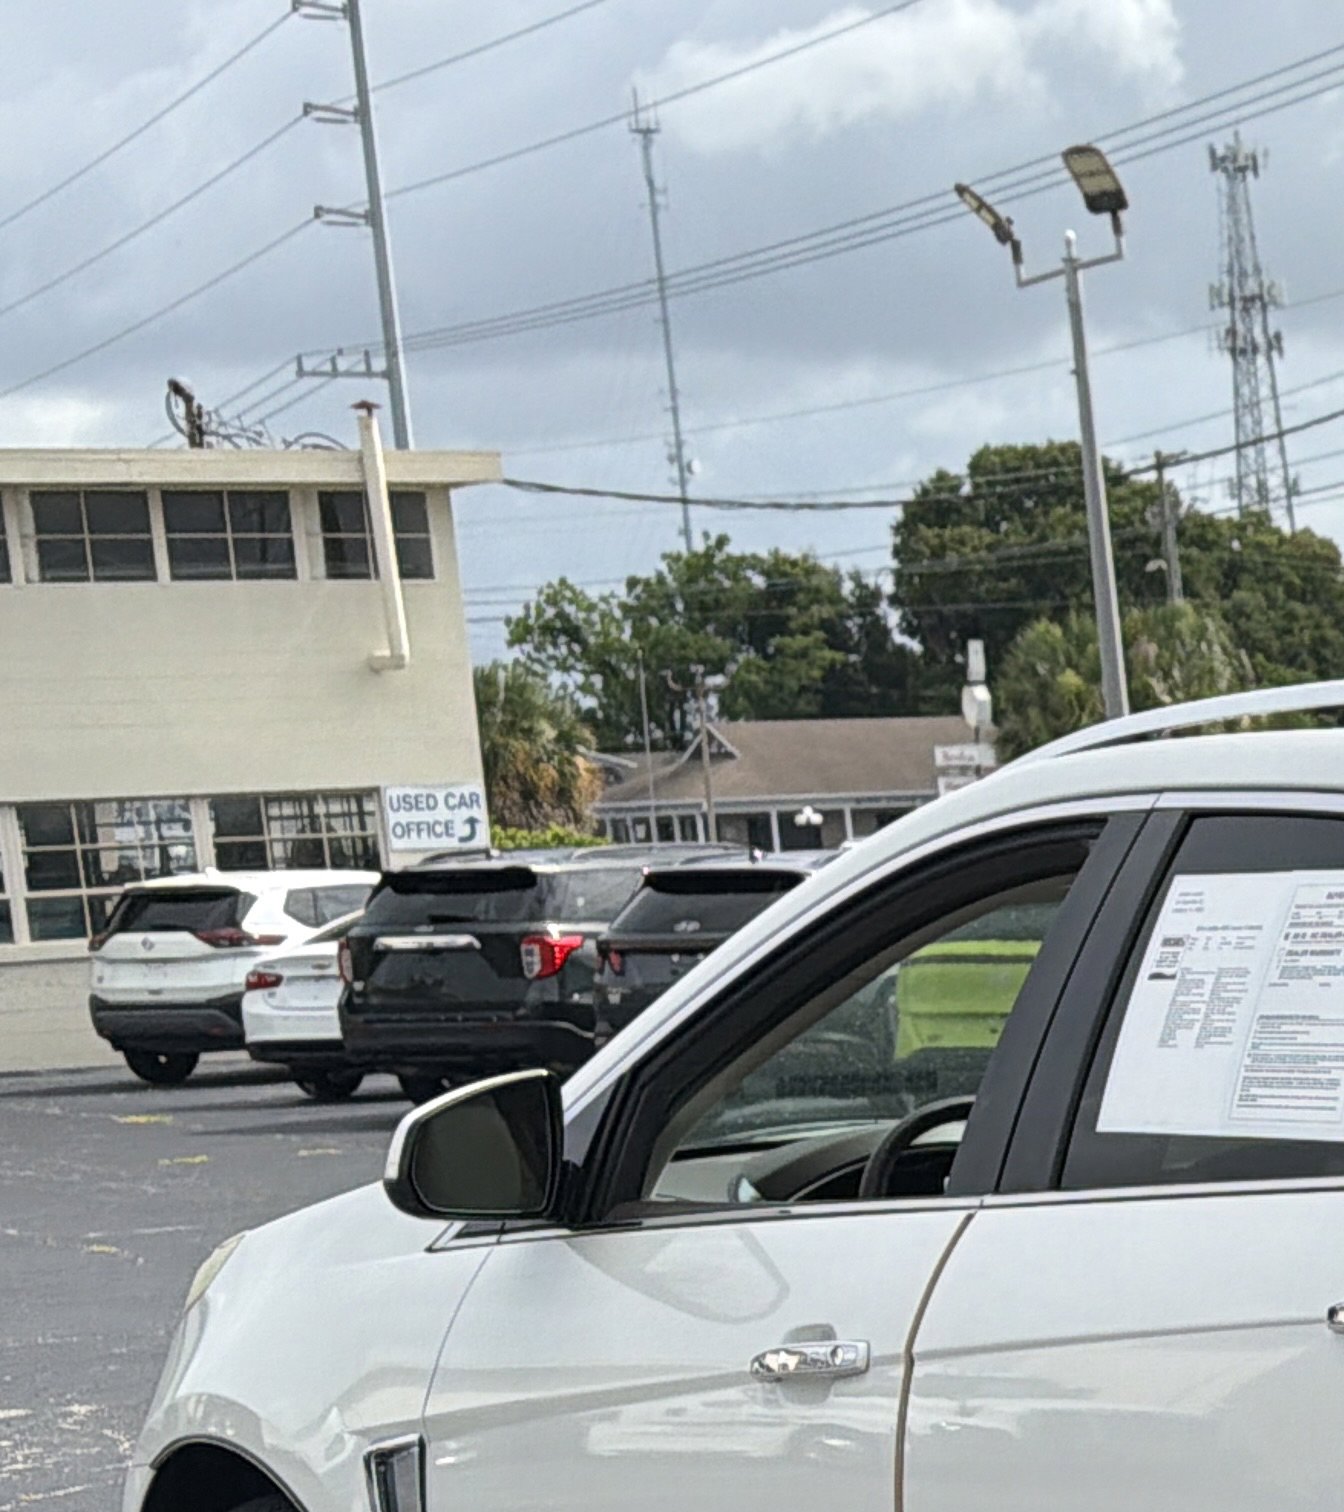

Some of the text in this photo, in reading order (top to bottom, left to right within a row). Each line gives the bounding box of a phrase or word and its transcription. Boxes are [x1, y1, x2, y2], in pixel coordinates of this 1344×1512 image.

[388, 791, 481, 813] USED CAR
[391, 820, 456, 840] OFFICE
